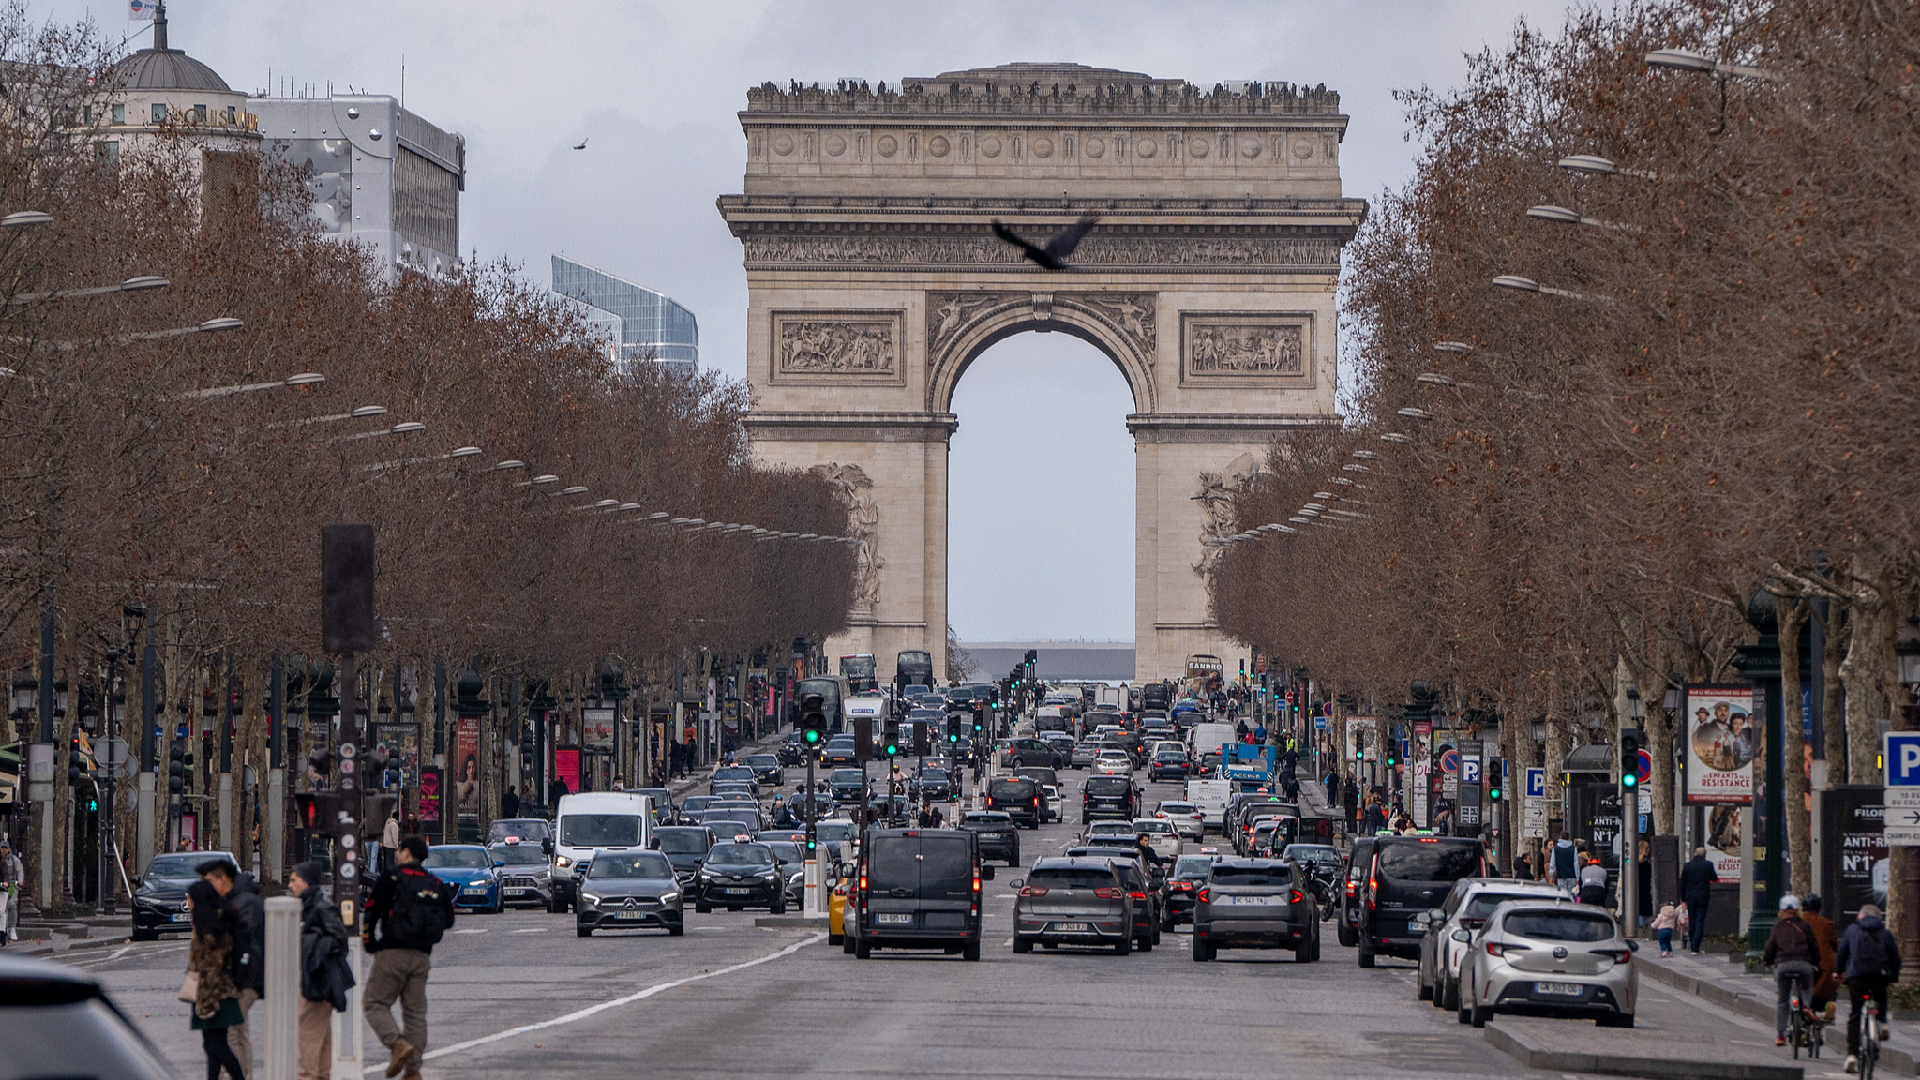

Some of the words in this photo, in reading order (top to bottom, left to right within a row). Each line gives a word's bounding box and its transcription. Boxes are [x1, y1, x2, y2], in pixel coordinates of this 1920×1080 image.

[175, 107, 229, 127] LOUIS
[1189, 662, 1222, 670] SANDRO
[1901, 743, 1920, 778] P
[1463, 762, 1478, 781] P
[1534, 773, 1543, 792] P
